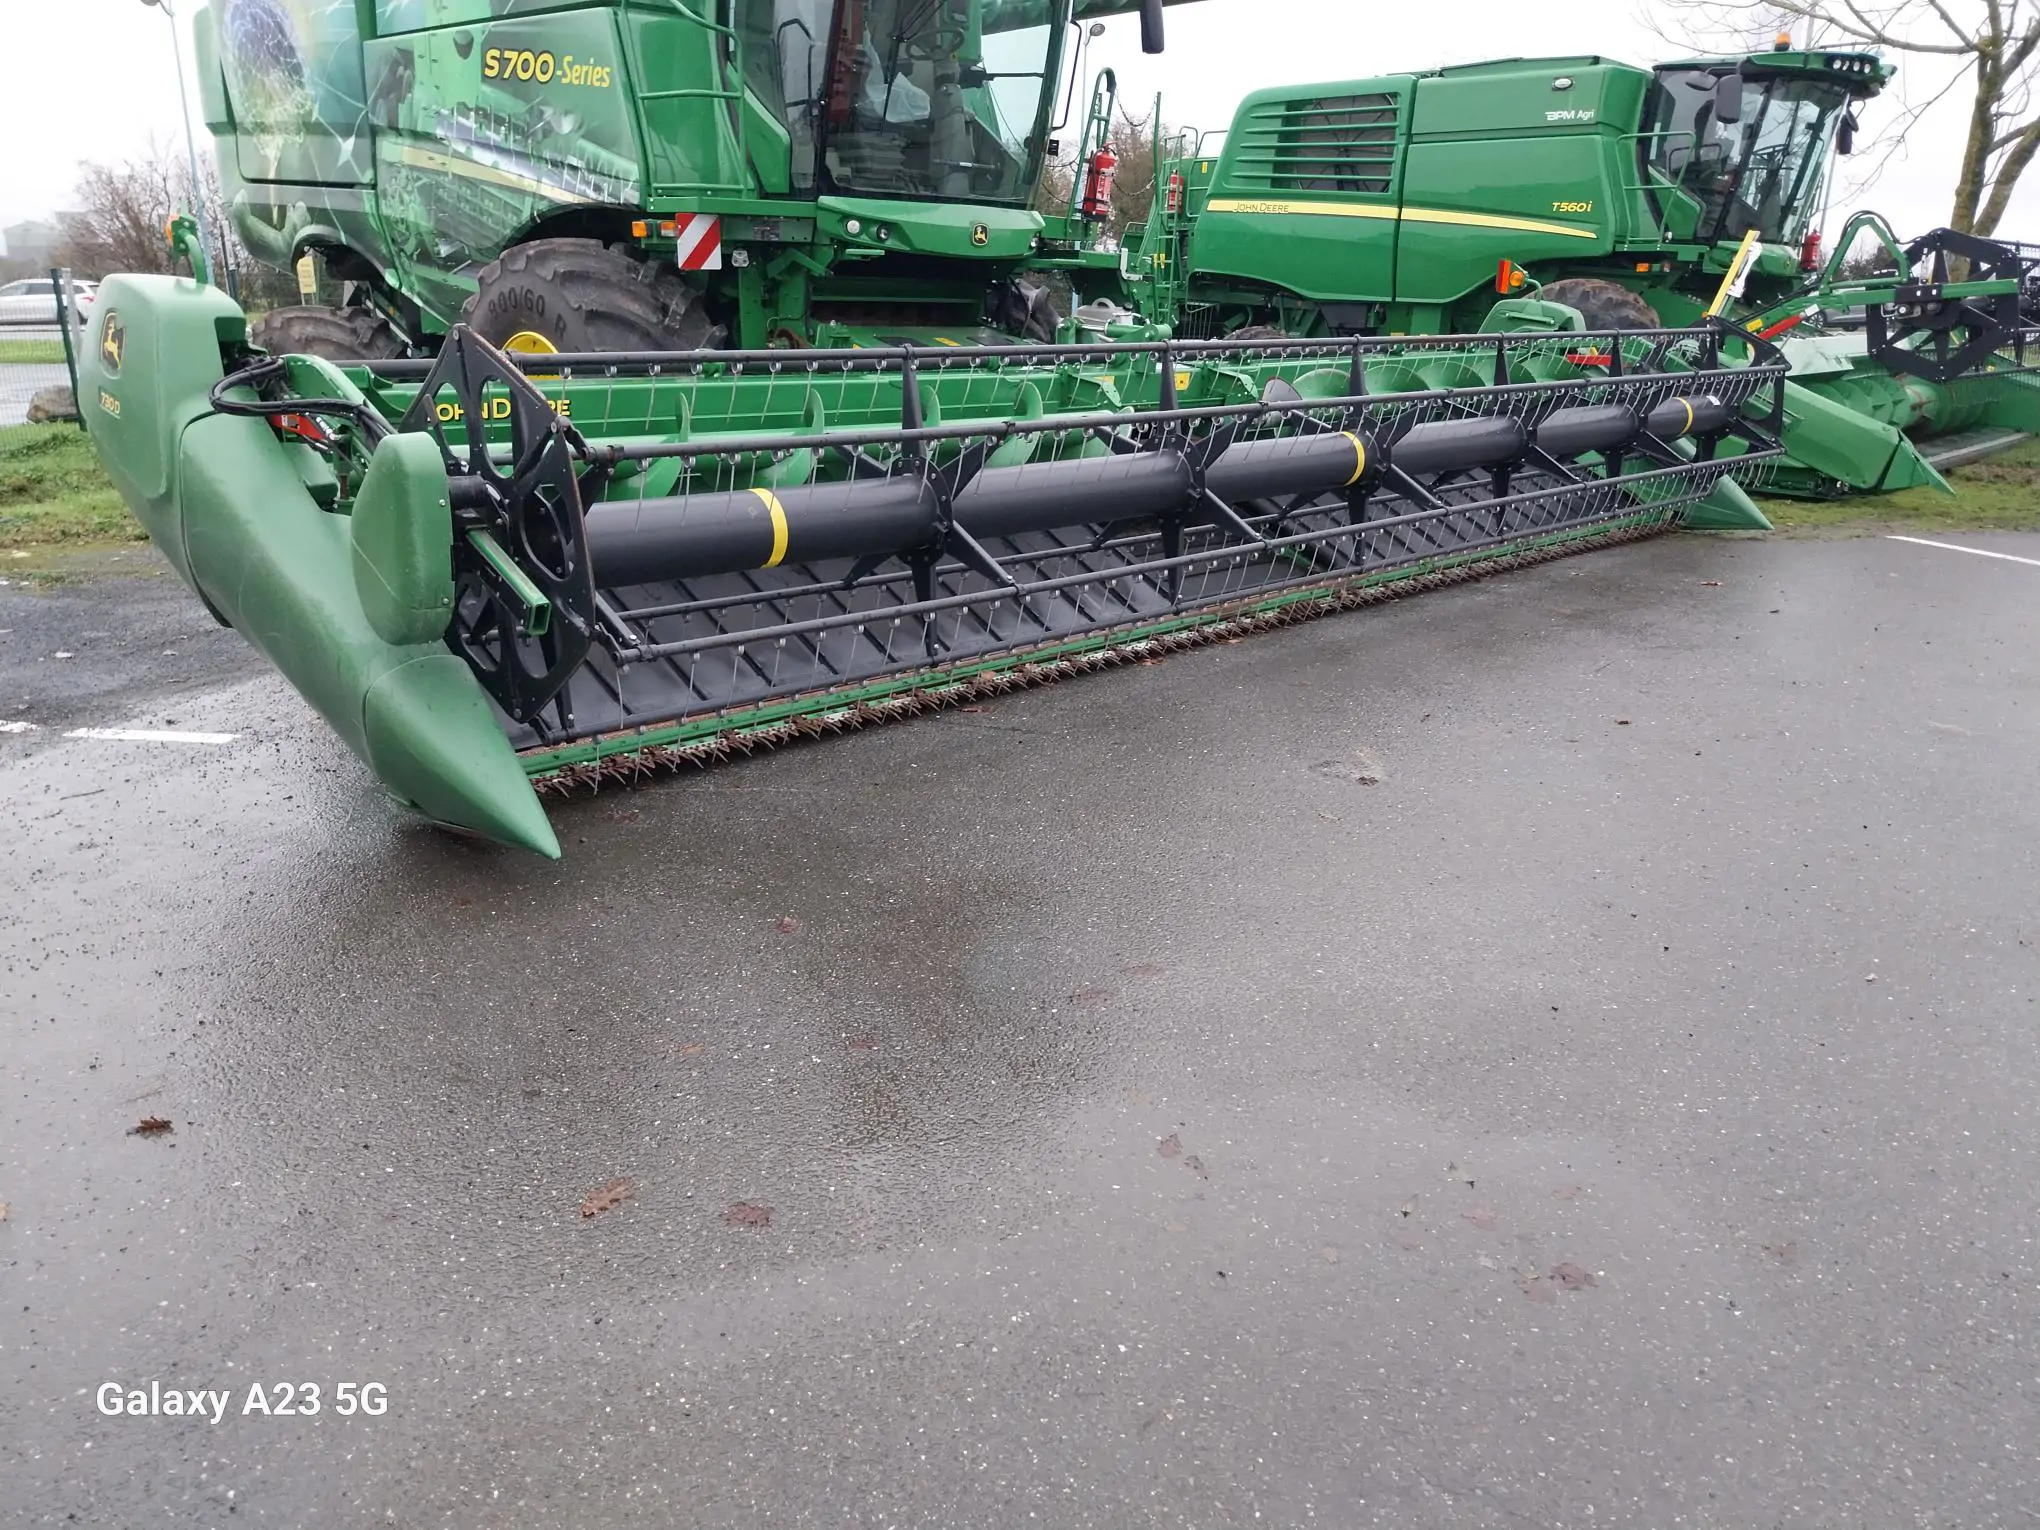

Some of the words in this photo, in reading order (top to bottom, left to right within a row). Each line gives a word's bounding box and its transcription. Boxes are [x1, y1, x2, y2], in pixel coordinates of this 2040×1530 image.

[1576, 109, 1595, 121] Agri
[1234, 202, 1258, 212] JOHN
[1259, 202, 1290, 213] DEERE
